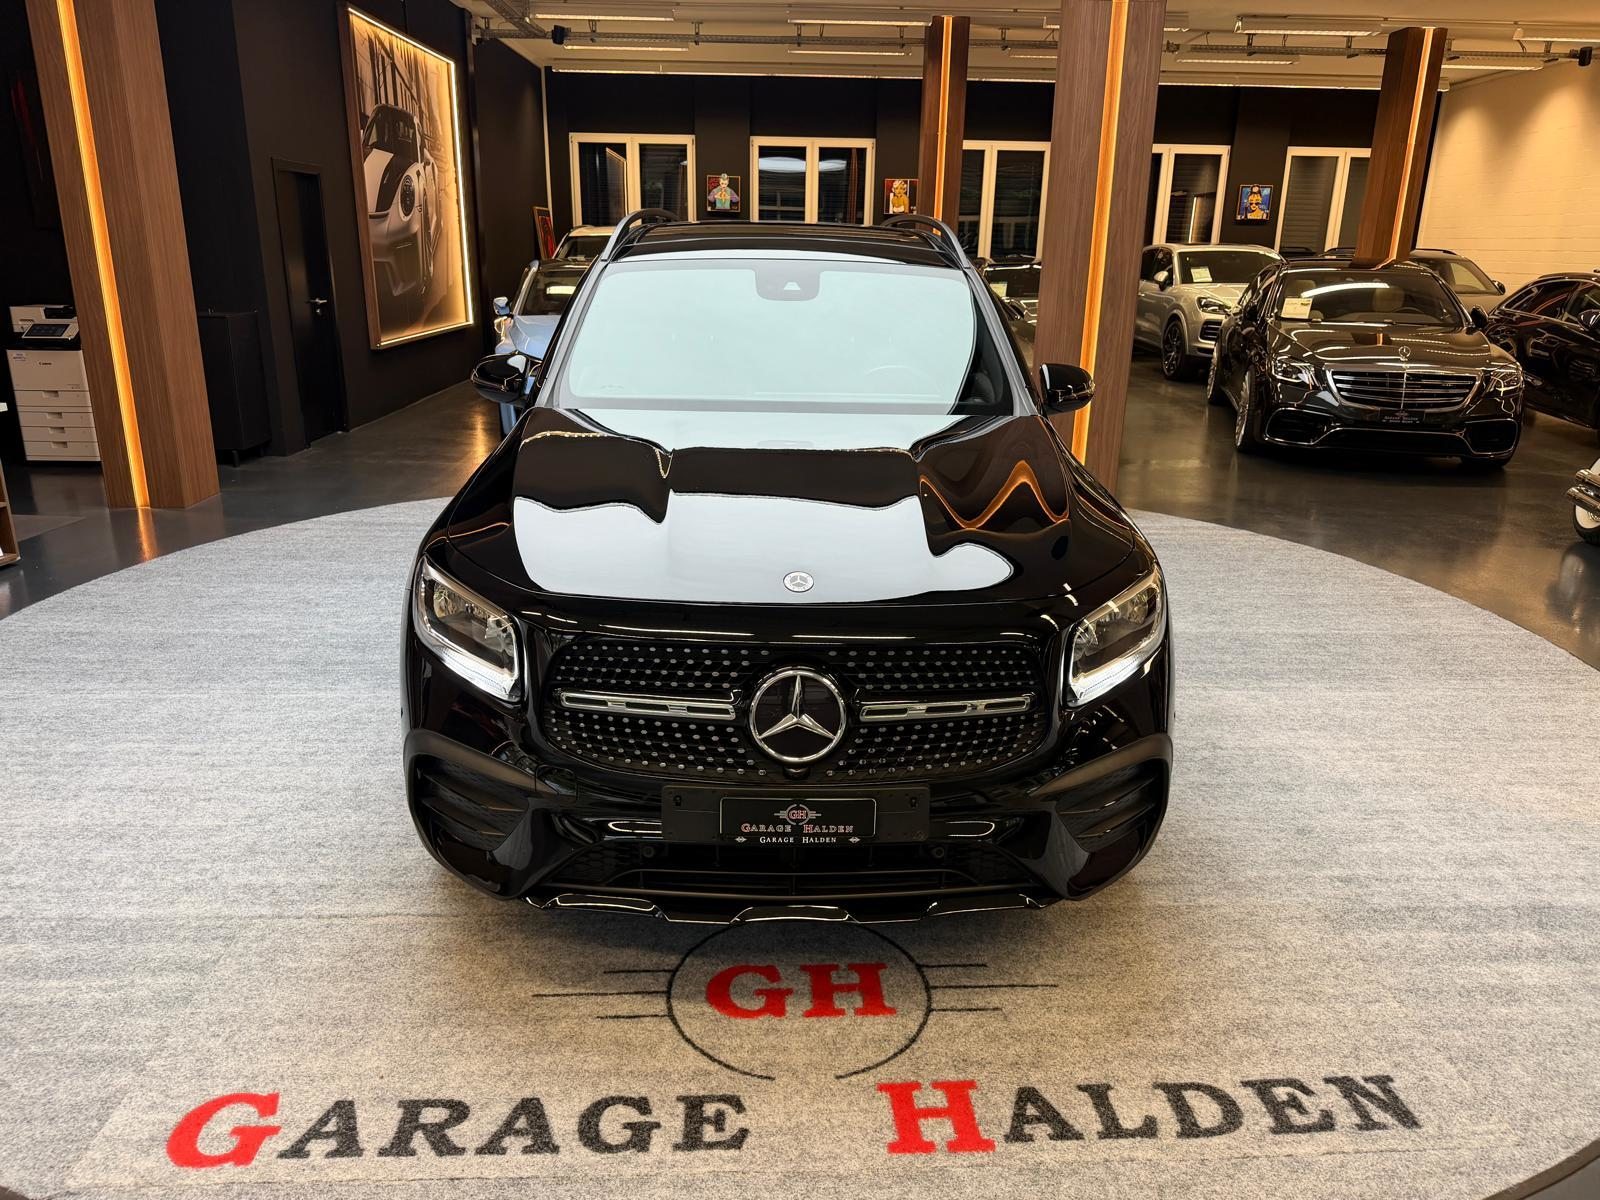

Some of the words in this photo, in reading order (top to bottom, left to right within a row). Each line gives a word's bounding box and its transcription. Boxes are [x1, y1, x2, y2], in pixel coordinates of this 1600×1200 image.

[740, 822, 792, 833] GARAGE
[802, 823, 854, 834] HALDEN
[759, 836, 795, 844] GARAGE
[802, 836, 837, 844] HALDEN
[706, 962, 896, 1019] GH
[166, 1092, 749, 1168] GARAGE
[876, 1074, 1422, 1154] HALDEN
